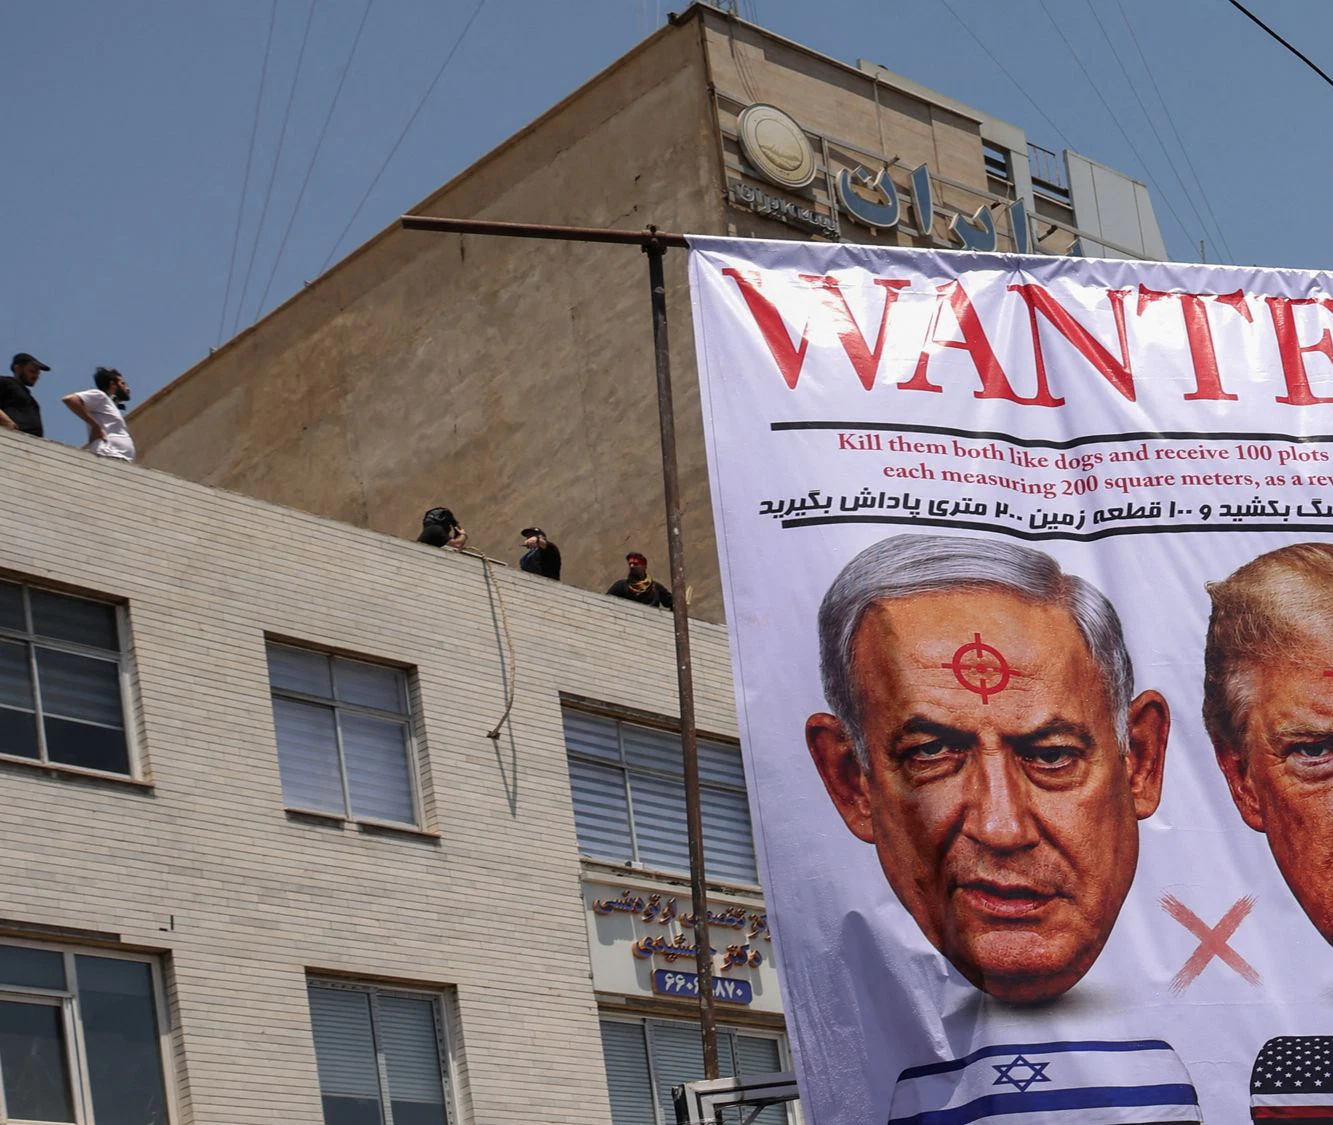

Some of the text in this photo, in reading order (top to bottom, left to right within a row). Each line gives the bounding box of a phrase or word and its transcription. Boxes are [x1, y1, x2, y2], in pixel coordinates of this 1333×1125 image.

[837, 431, 882, 451] Kill
[887, 435, 949, 455] them
[952, 439, 1004, 462] both
[1008, 446, 1049, 469] like
[1054, 448, 1104, 472] dogs
[1109, 444, 1148, 463] and
[1154, 444, 1230, 462] receive
[1234, 444, 1273, 461] 100
[1278, 445, 1330, 467] plots
[882, 462, 936, 481] each
[940, 470, 1057, 498] measuring
[1060, 475, 1099, 497] 200
[1103, 473, 1176, 495] square
[1180, 470, 1261, 490] meters,
[1264, 474, 1286, 487] as
[1291, 475, 1303, 487] a
[758, 488, 834, 518] بگیرید
[839, 485, 922, 519] پاداش
[1092, 499, 1162, 526] قطعه
[1199, 504, 1212, 520] و
[1218, 495, 1291, 523] بکشید
